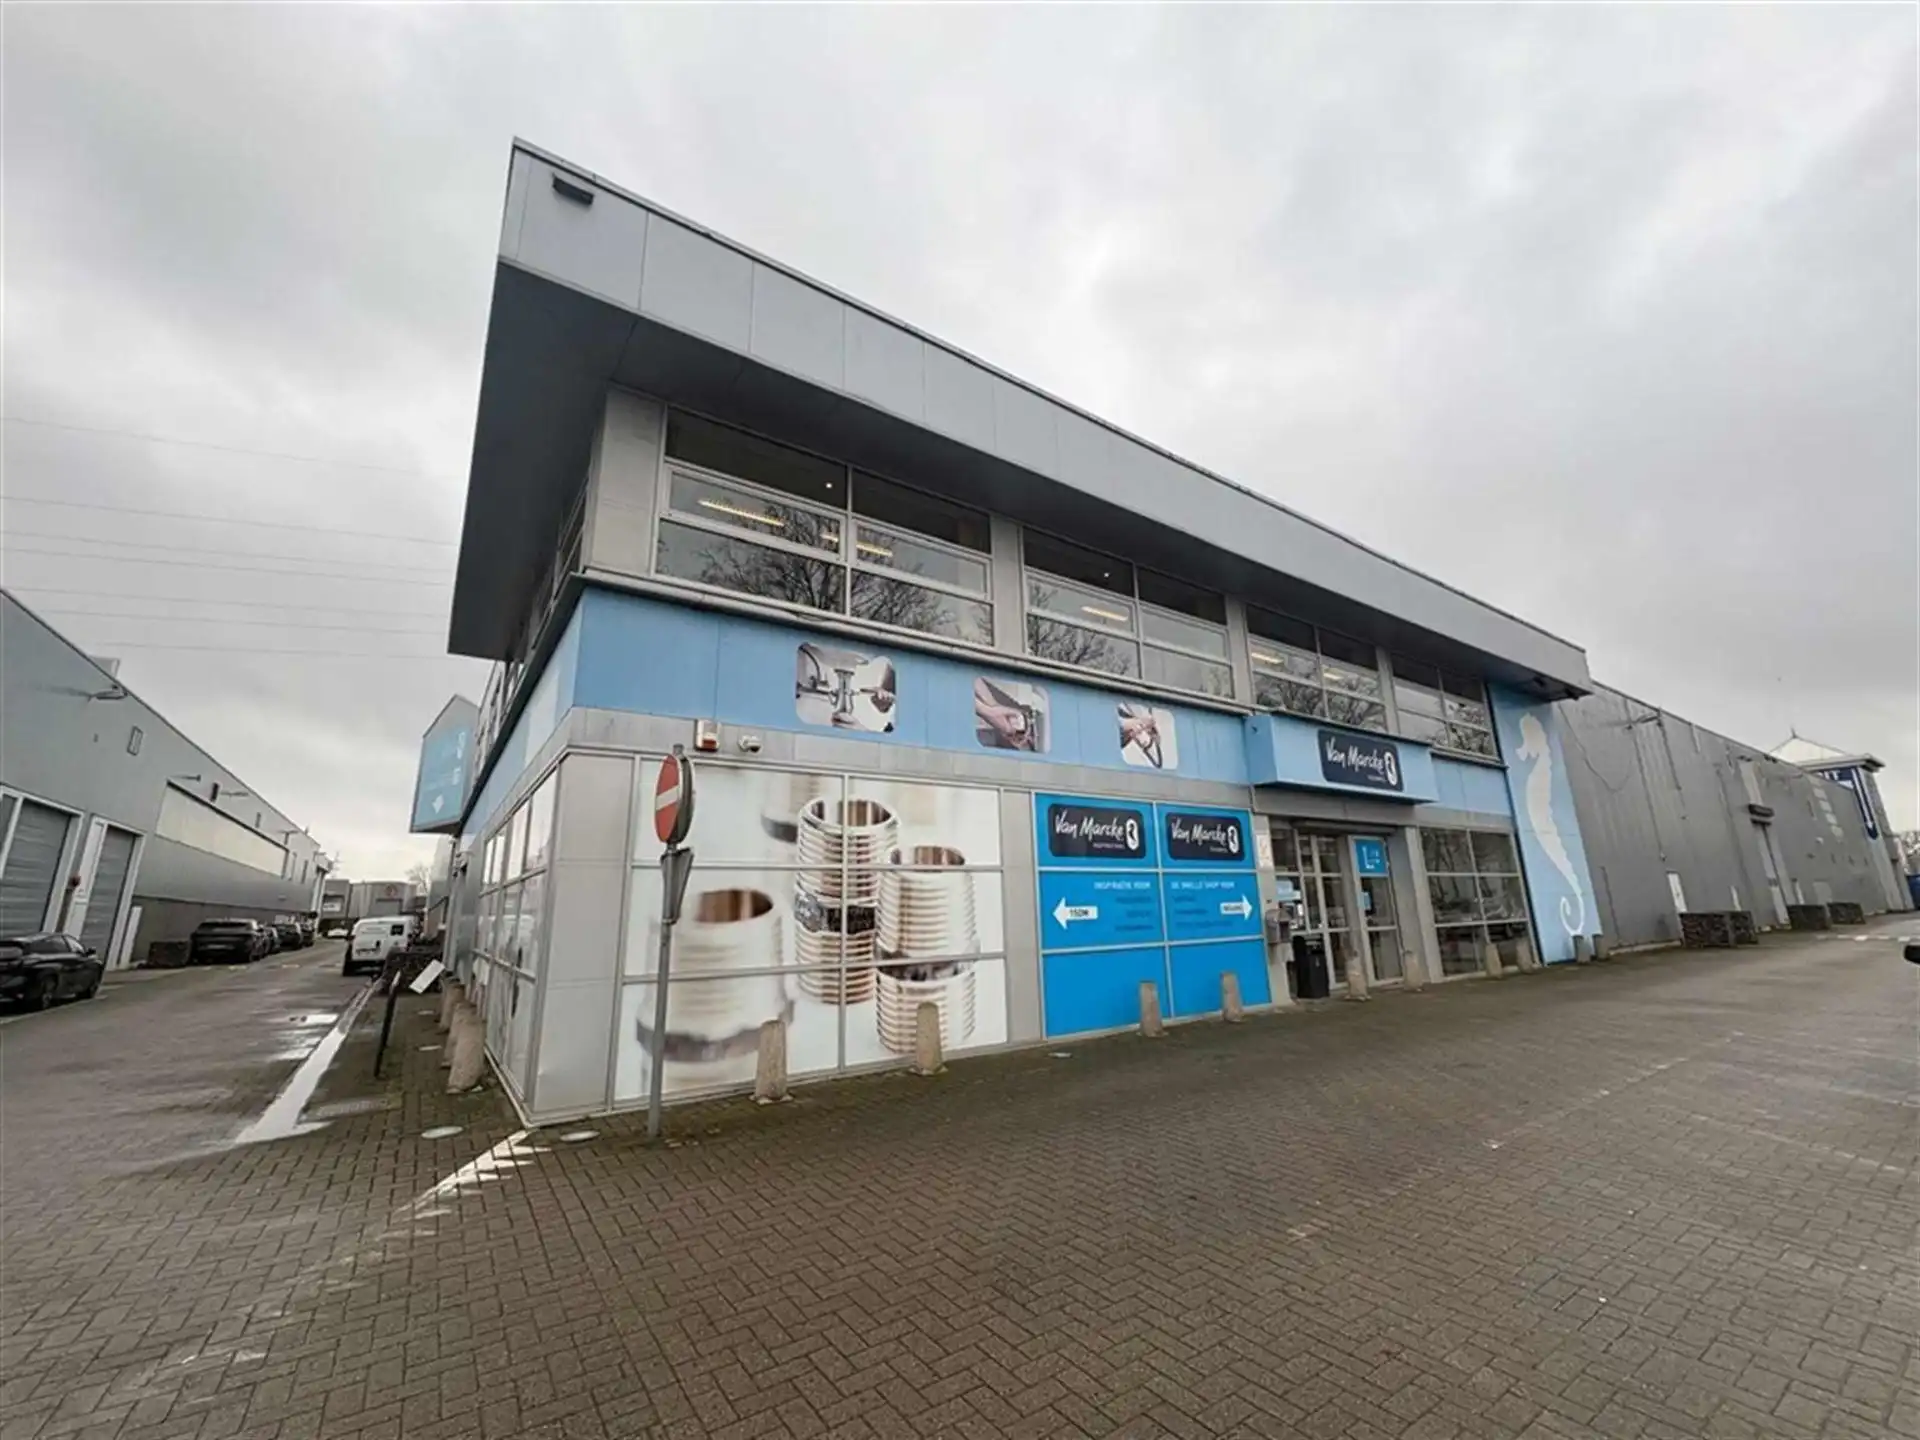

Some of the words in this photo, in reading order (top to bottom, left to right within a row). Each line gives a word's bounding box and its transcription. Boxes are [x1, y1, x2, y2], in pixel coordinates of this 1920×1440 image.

[1326, 737, 1346, 769] Van
[1347, 745, 1385, 776] Marcke
[1055, 809, 1078, 839] Van
[1079, 816, 1125, 842] Marcke
[1171, 817, 1190, 844] Van
[1191, 823, 1228, 846] Marcke
